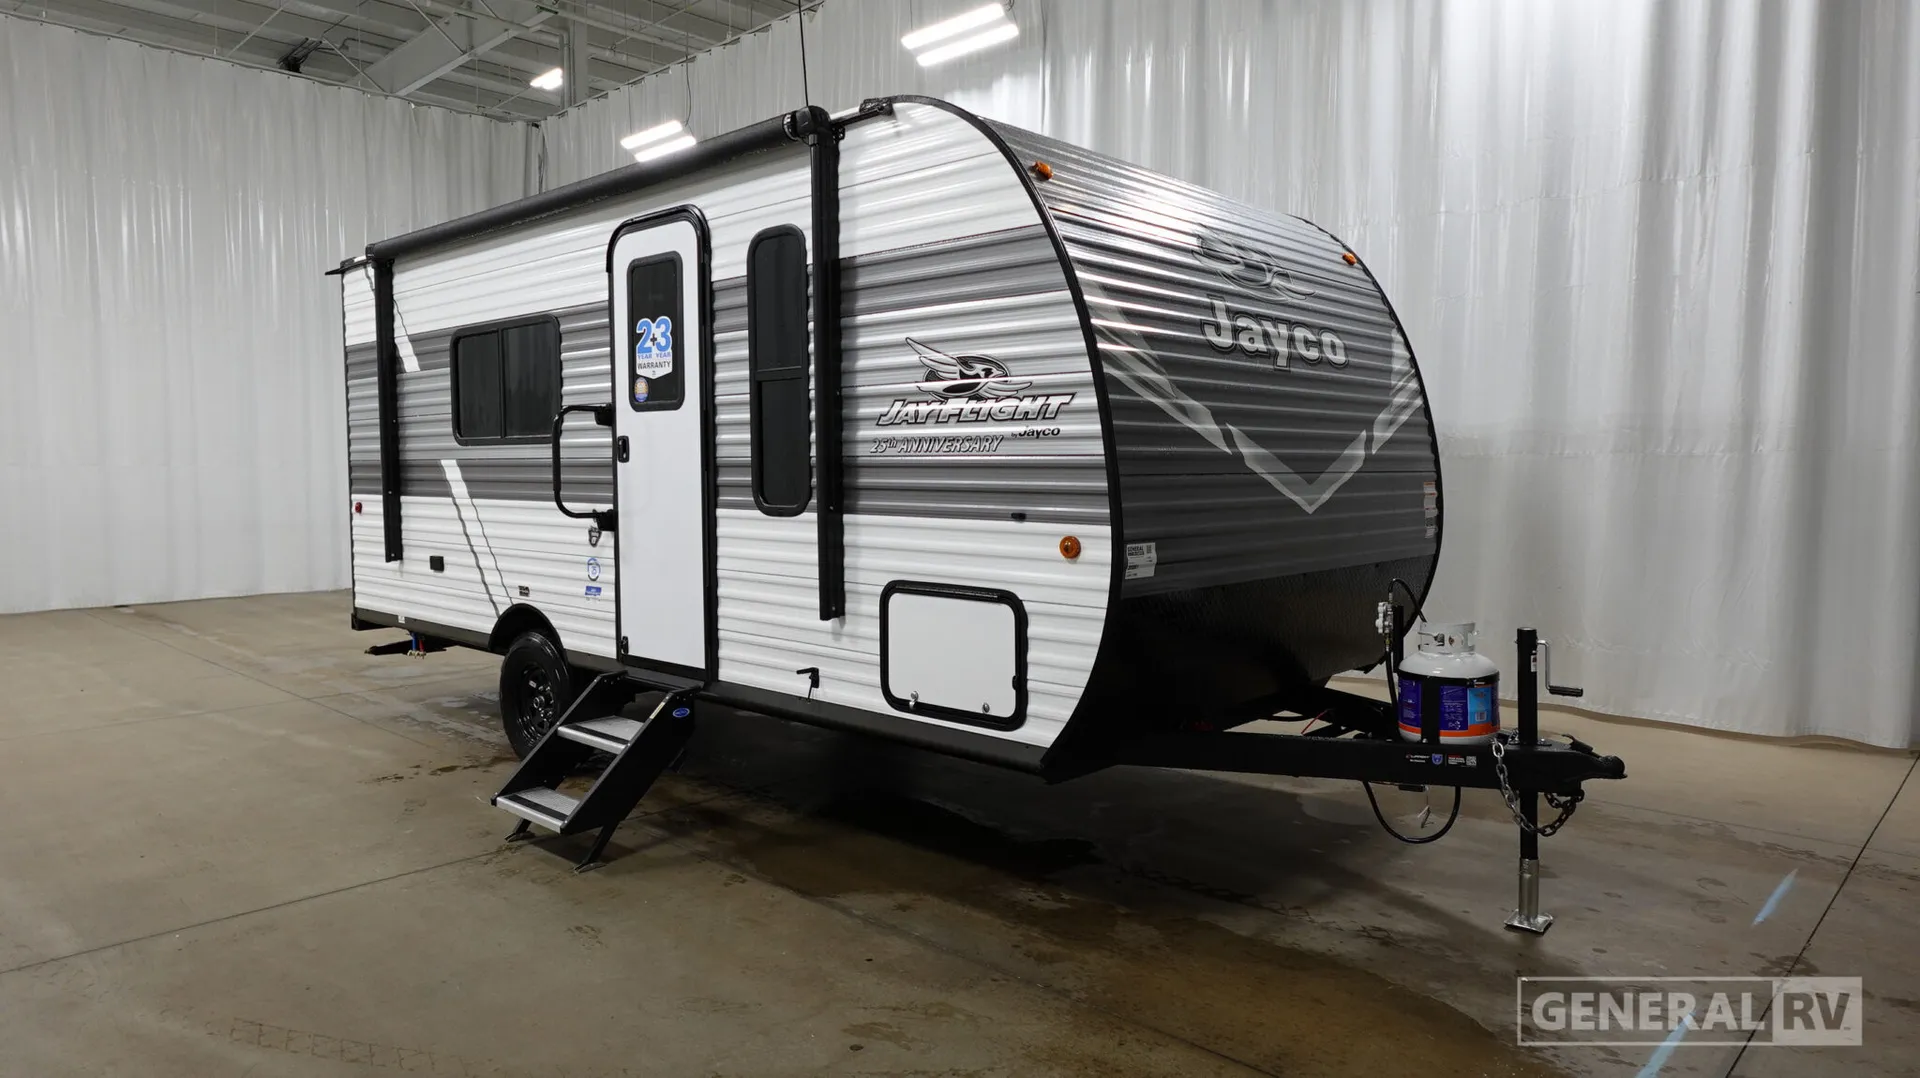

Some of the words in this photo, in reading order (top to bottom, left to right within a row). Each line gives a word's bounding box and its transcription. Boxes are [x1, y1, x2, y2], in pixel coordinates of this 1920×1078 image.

[1201, 294, 1348, 372] Jayco
[638, 361, 671, 370] WARRANTY
[1019, 425, 1060, 439] Jayco
[869, 437, 898, 453] 25th
[898, 435, 1004, 453] ANNIVERSARY
